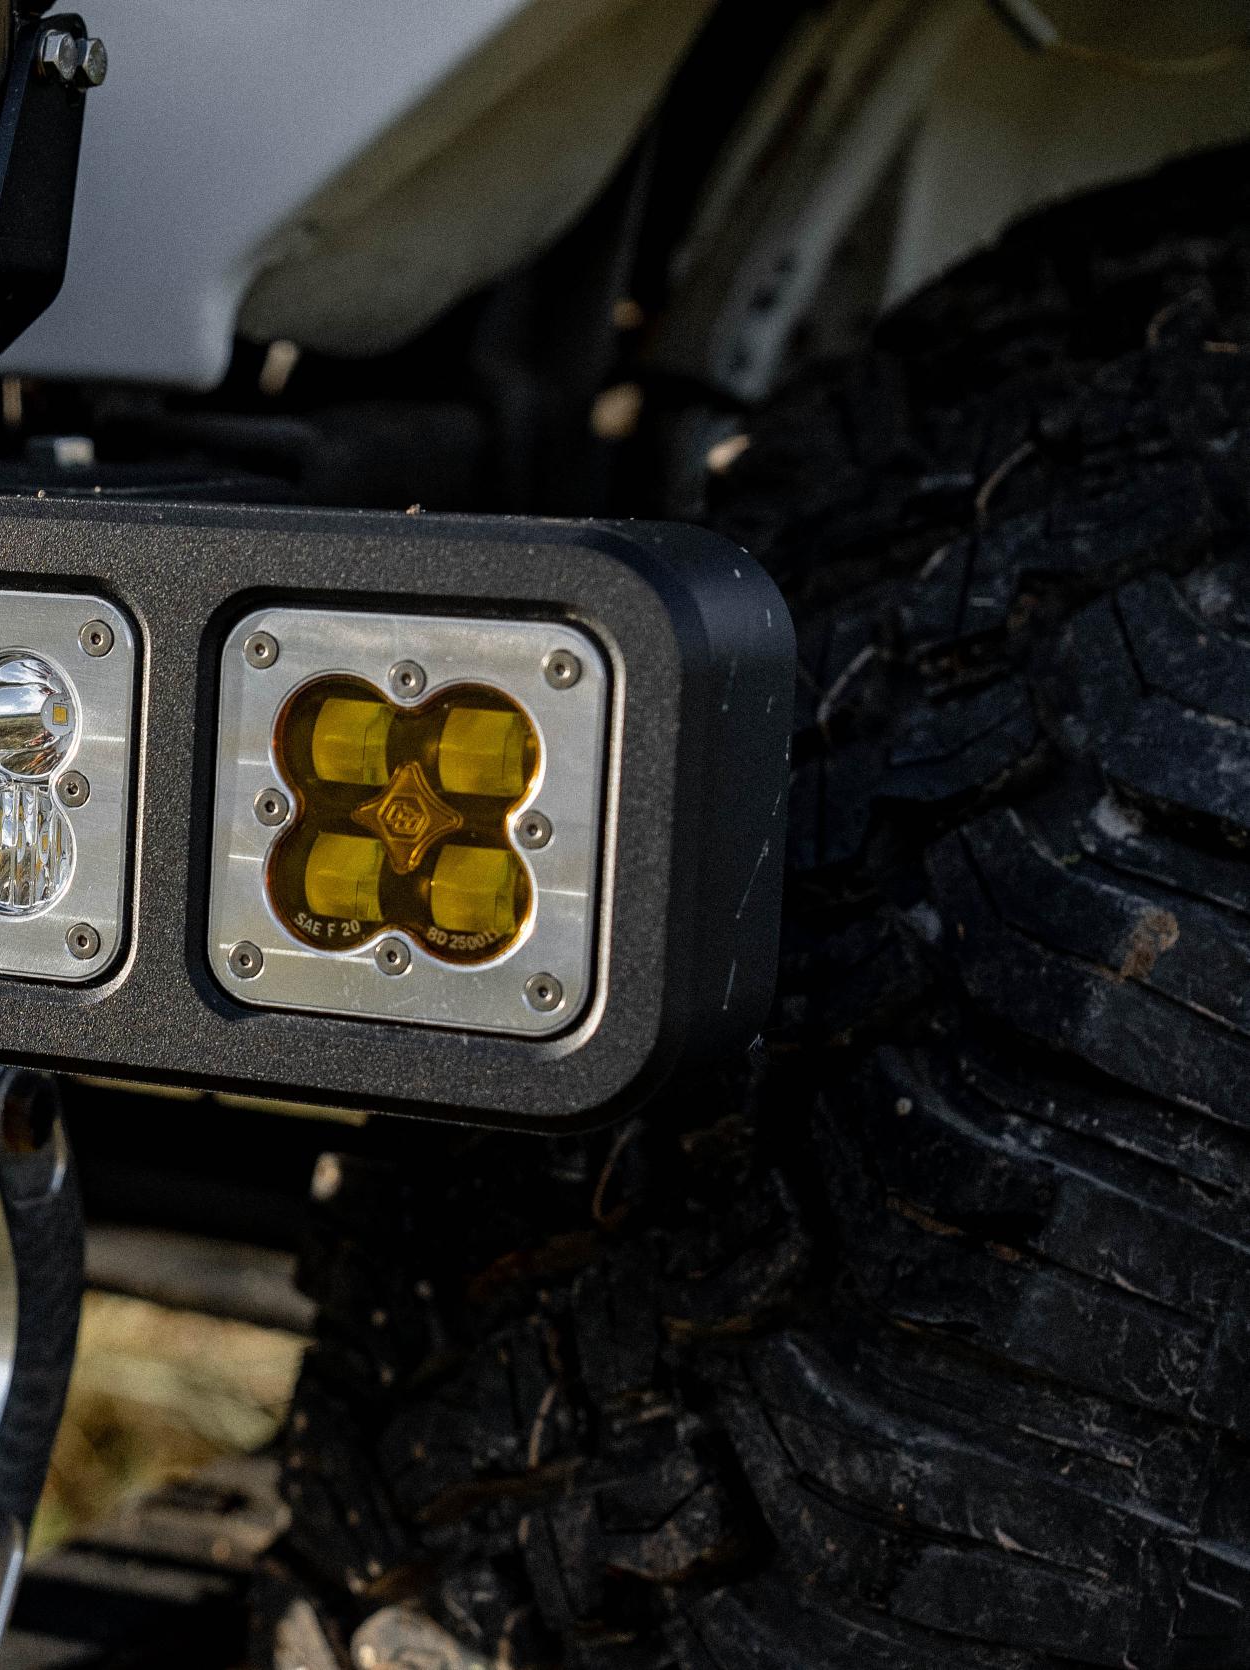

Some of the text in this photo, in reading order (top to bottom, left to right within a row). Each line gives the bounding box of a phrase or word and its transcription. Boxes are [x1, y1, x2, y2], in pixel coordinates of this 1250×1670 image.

[294, 912, 361, 937] SAE F 20
